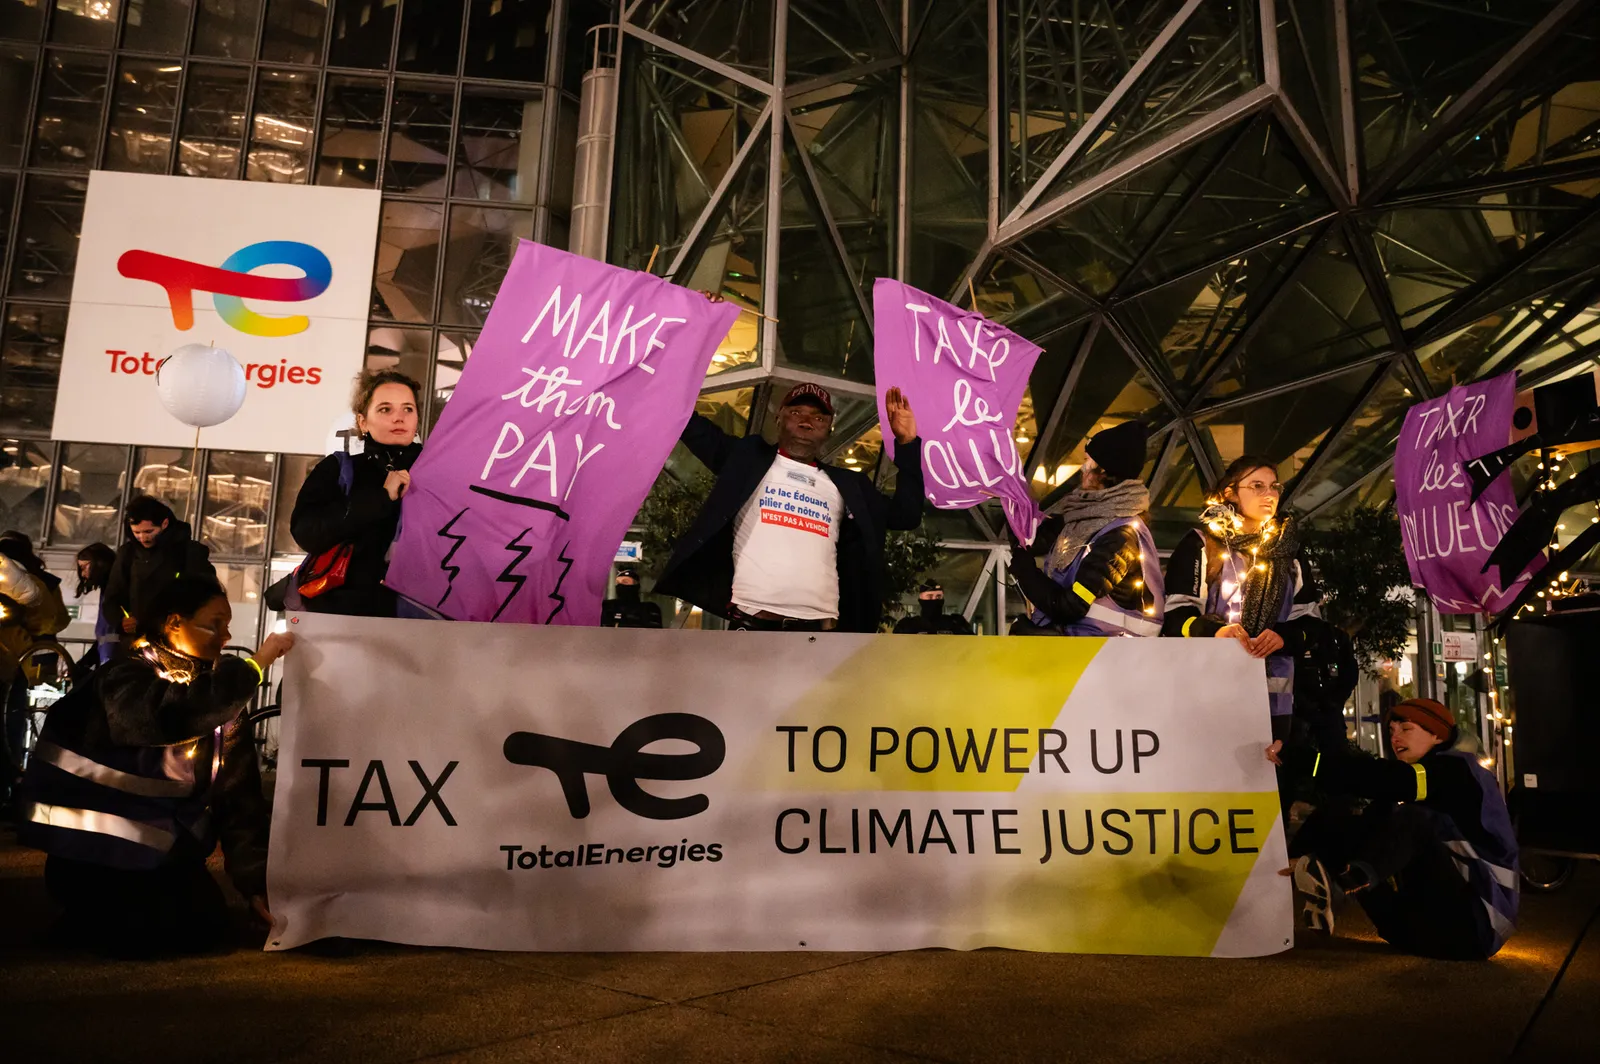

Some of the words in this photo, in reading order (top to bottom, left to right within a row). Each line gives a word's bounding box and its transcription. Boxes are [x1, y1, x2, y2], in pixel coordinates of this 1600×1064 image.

[521, 285, 687, 375] MAKE
[105, 350, 322, 389] Totrgies
[480, 421, 606, 501] PAY
[759, 497, 783, 508] pilier
[784, 502, 796, 512] de
[797, 507, 821, 519] nôtre
[822, 513, 832, 523] vie
[762, 512, 783, 522] N'EST
[783, 516, 798, 525] PAS
[765, 486, 776, 495] Le
[778, 488, 792, 498] lac
[793, 490, 830, 511] Édouard,
[775, 725, 847, 773] TO
[869, 725, 1071, 774] POWER
[1090, 728, 1161, 774] UP
[301, 759, 460, 827] TAX
[499, 838, 724, 870] TotalEnergies
[774, 807, 1022, 855] CLIMATE
[1039, 808, 1260, 865] JUSTICE
